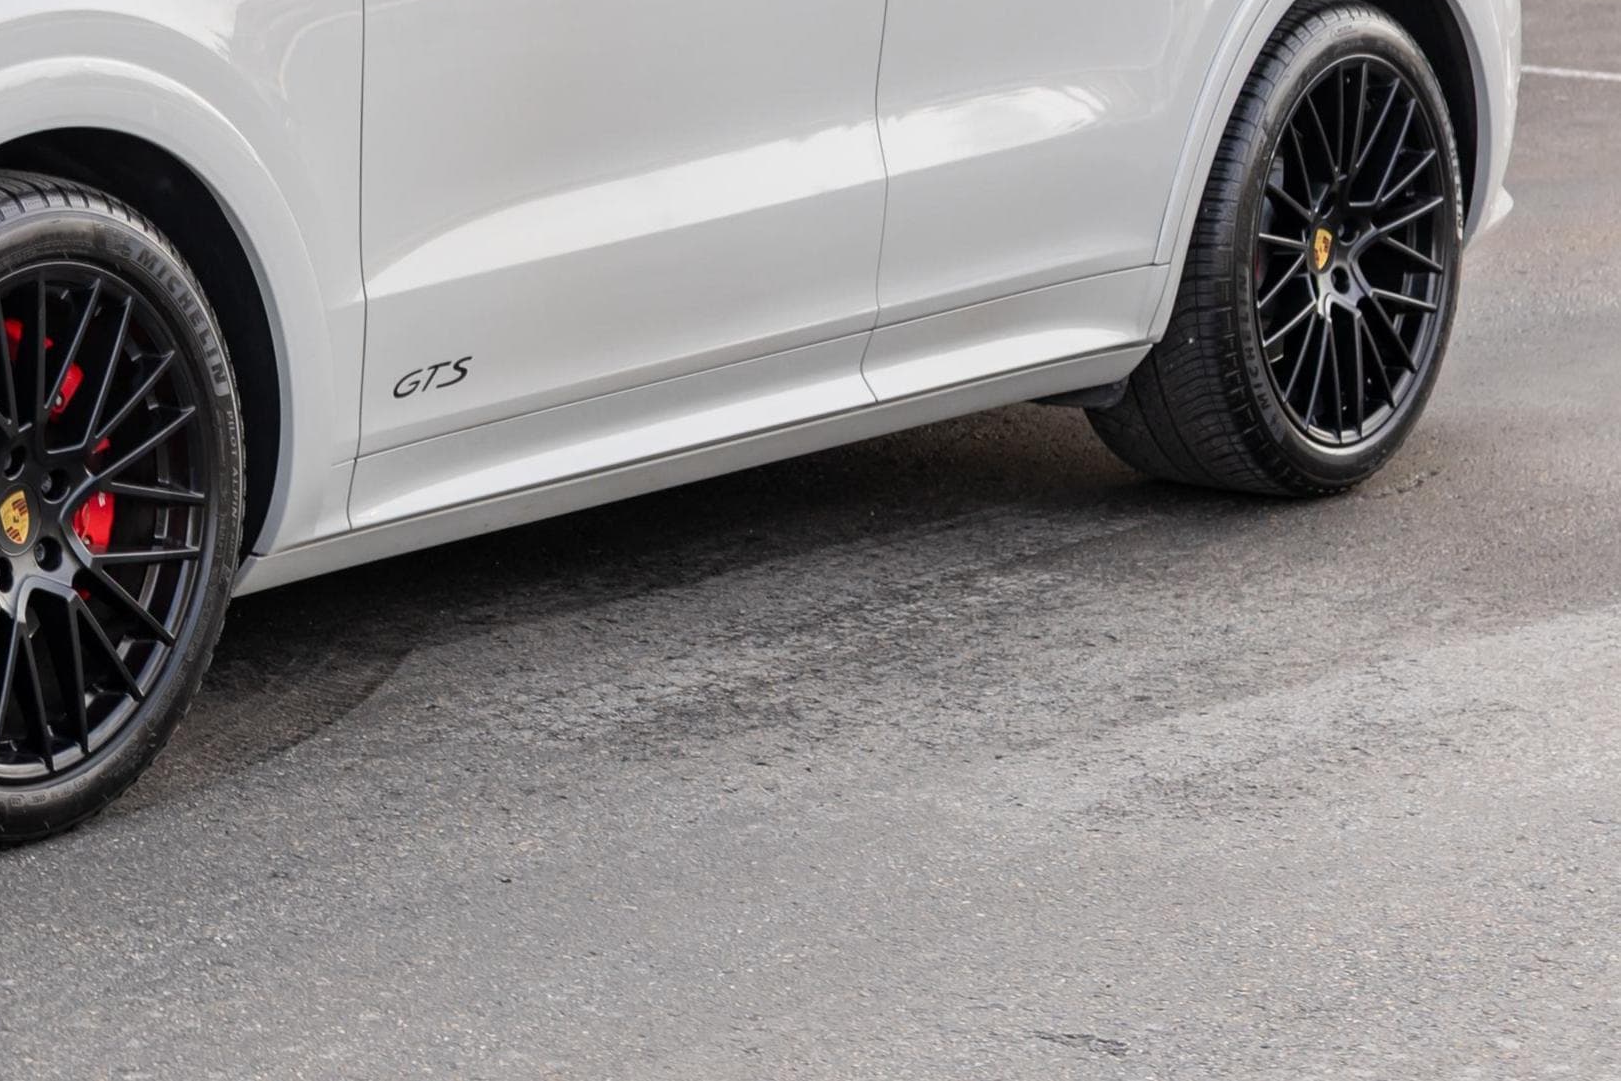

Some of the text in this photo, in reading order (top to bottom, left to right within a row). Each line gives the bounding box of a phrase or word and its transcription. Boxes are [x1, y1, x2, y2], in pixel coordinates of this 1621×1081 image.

[136, 249, 227, 384] MICHELIN
[393, 355, 473, 399] GTS
[226, 410, 237, 456] PILOT
